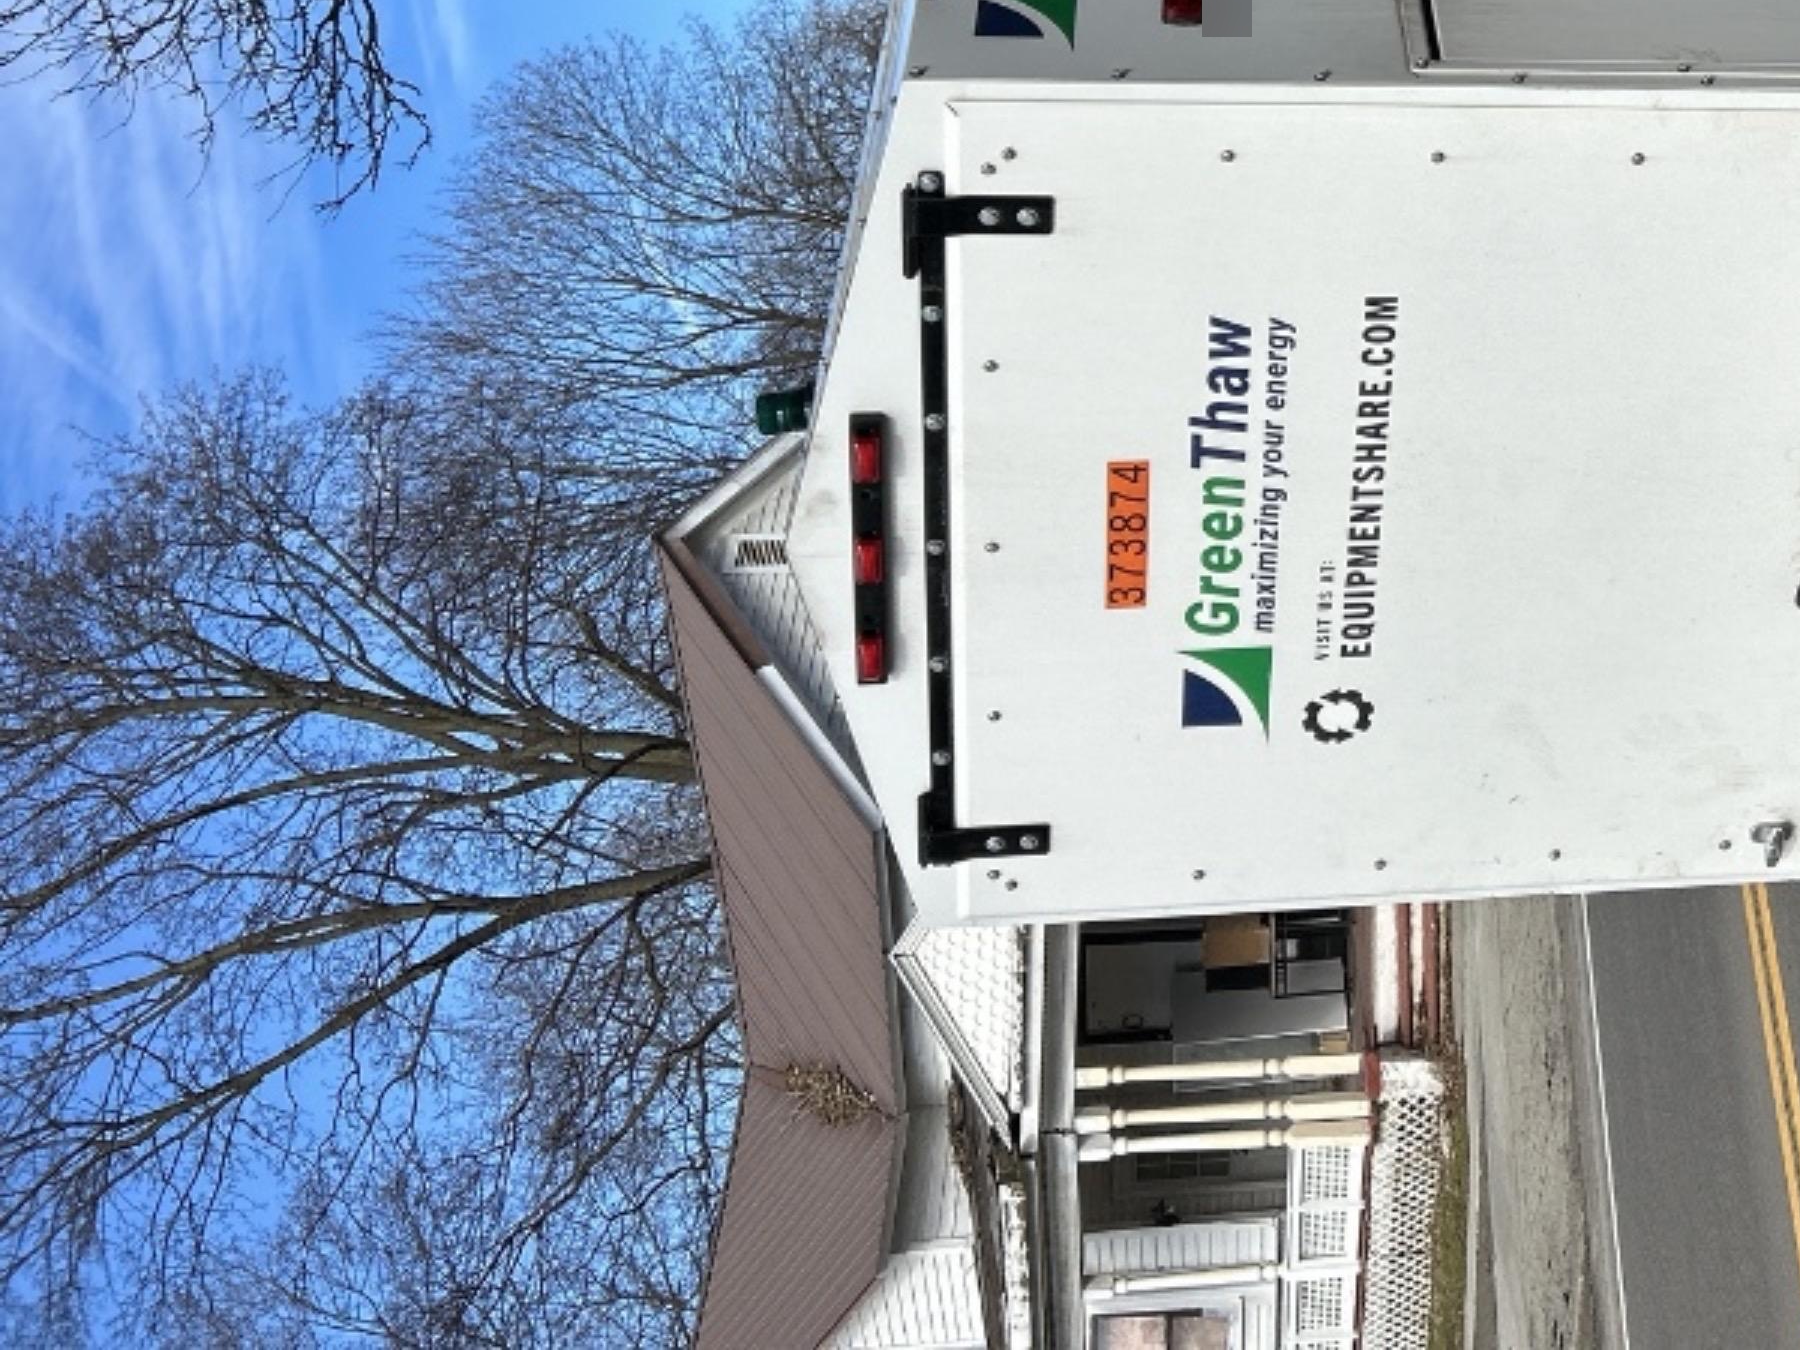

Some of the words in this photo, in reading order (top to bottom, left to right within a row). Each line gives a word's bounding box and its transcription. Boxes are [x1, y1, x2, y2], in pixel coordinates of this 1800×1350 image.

[1265, 317, 1297, 410] energy
[1262, 419, 1288, 478] your
[1340, 295, 1399, 659] EQUIPMENTSHARE.COM
[1107, 462, 1147, 606] 373874
[1253, 486, 1288, 633] maximizing
[1319, 559, 1335, 583] AT:
[1314, 618, 1332, 661] VISIT
